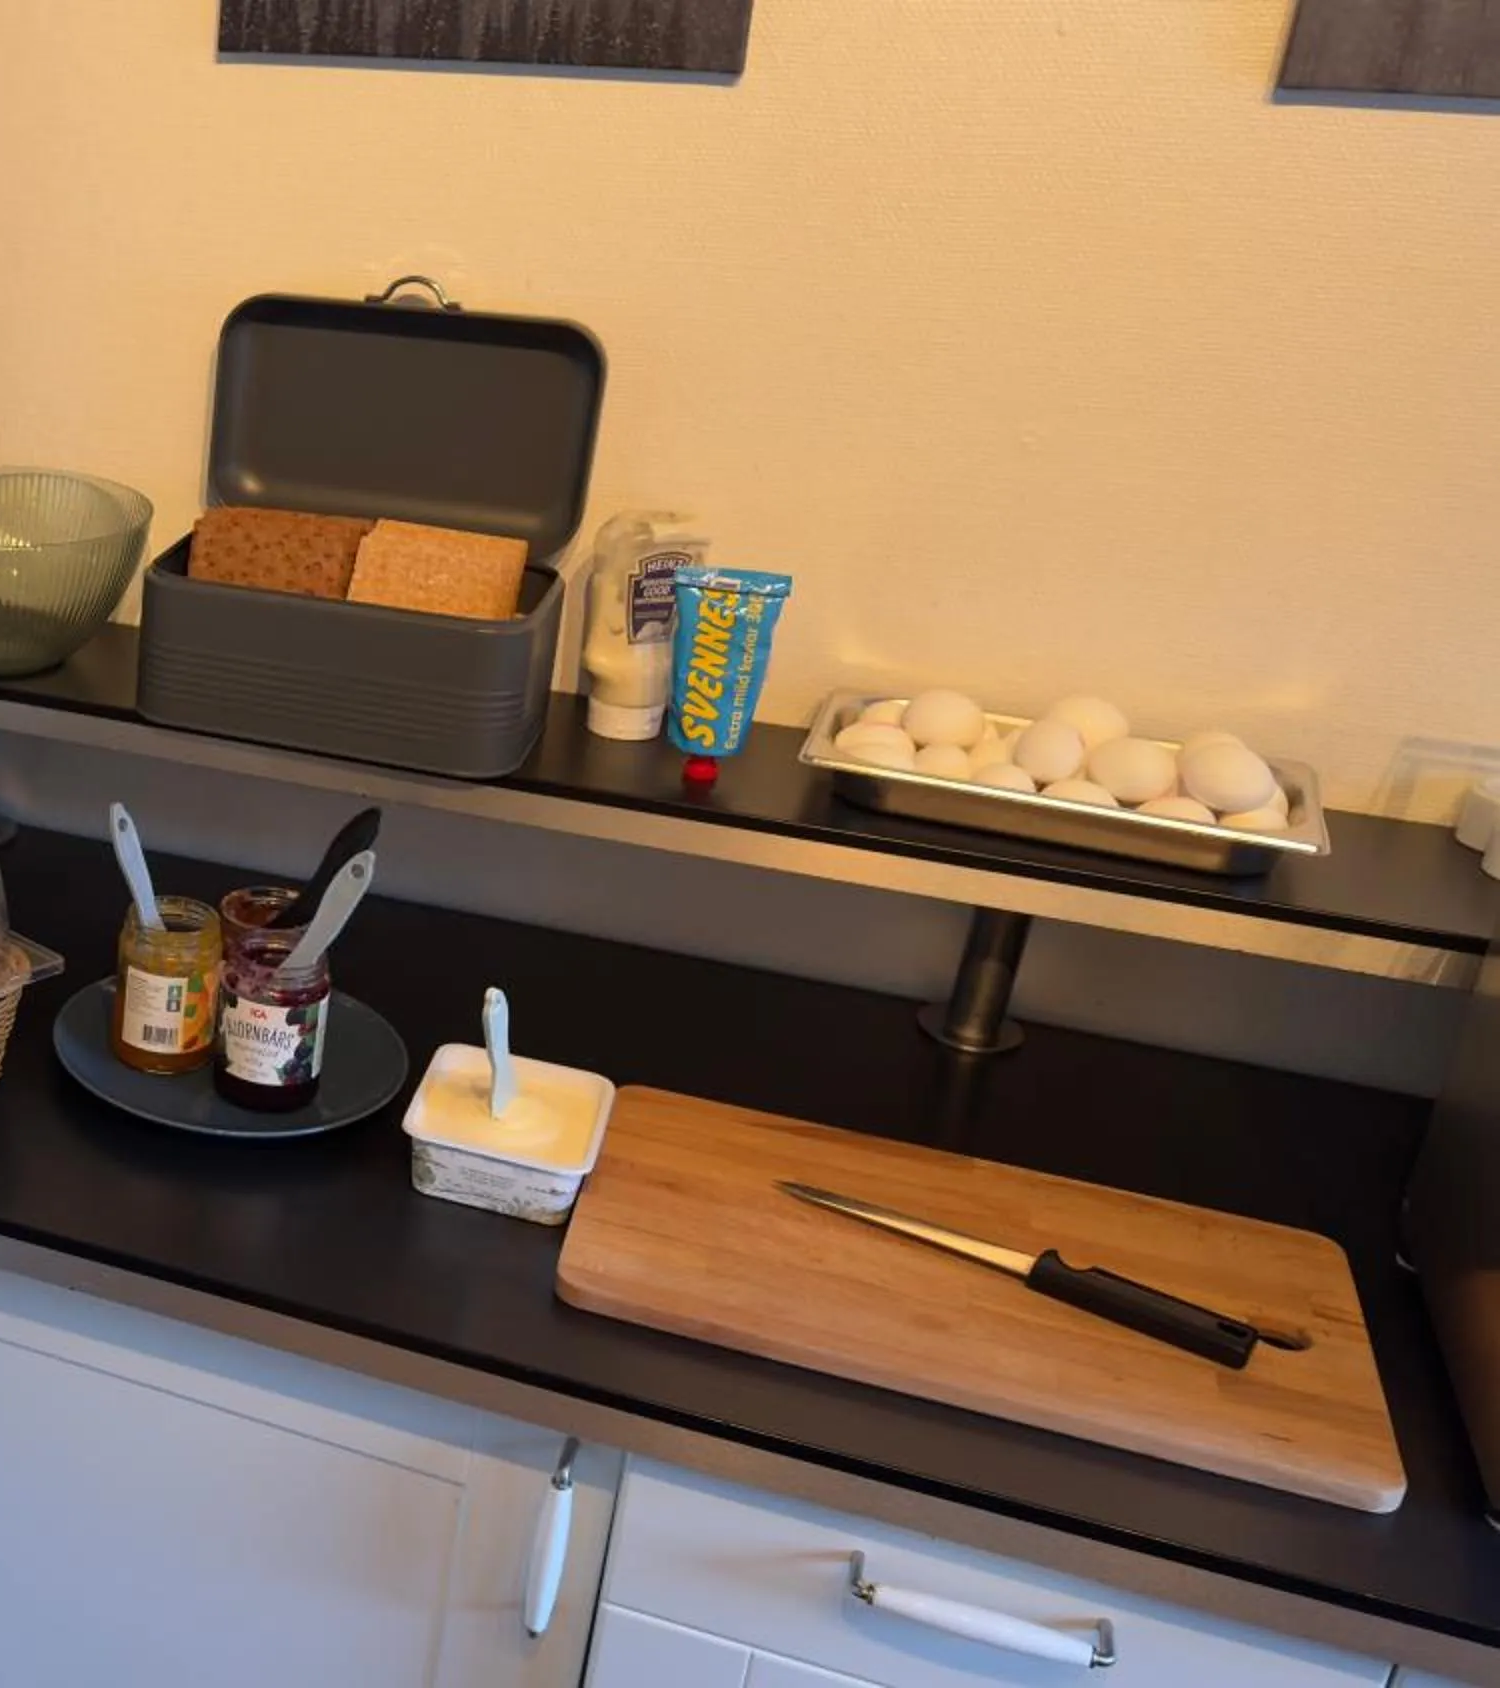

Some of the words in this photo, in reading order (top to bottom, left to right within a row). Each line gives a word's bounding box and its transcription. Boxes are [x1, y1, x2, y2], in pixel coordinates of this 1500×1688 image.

[681, 589, 740, 747] SVENNES
[724, 712, 742, 750] Extra
[733, 674, 749, 708] mild
